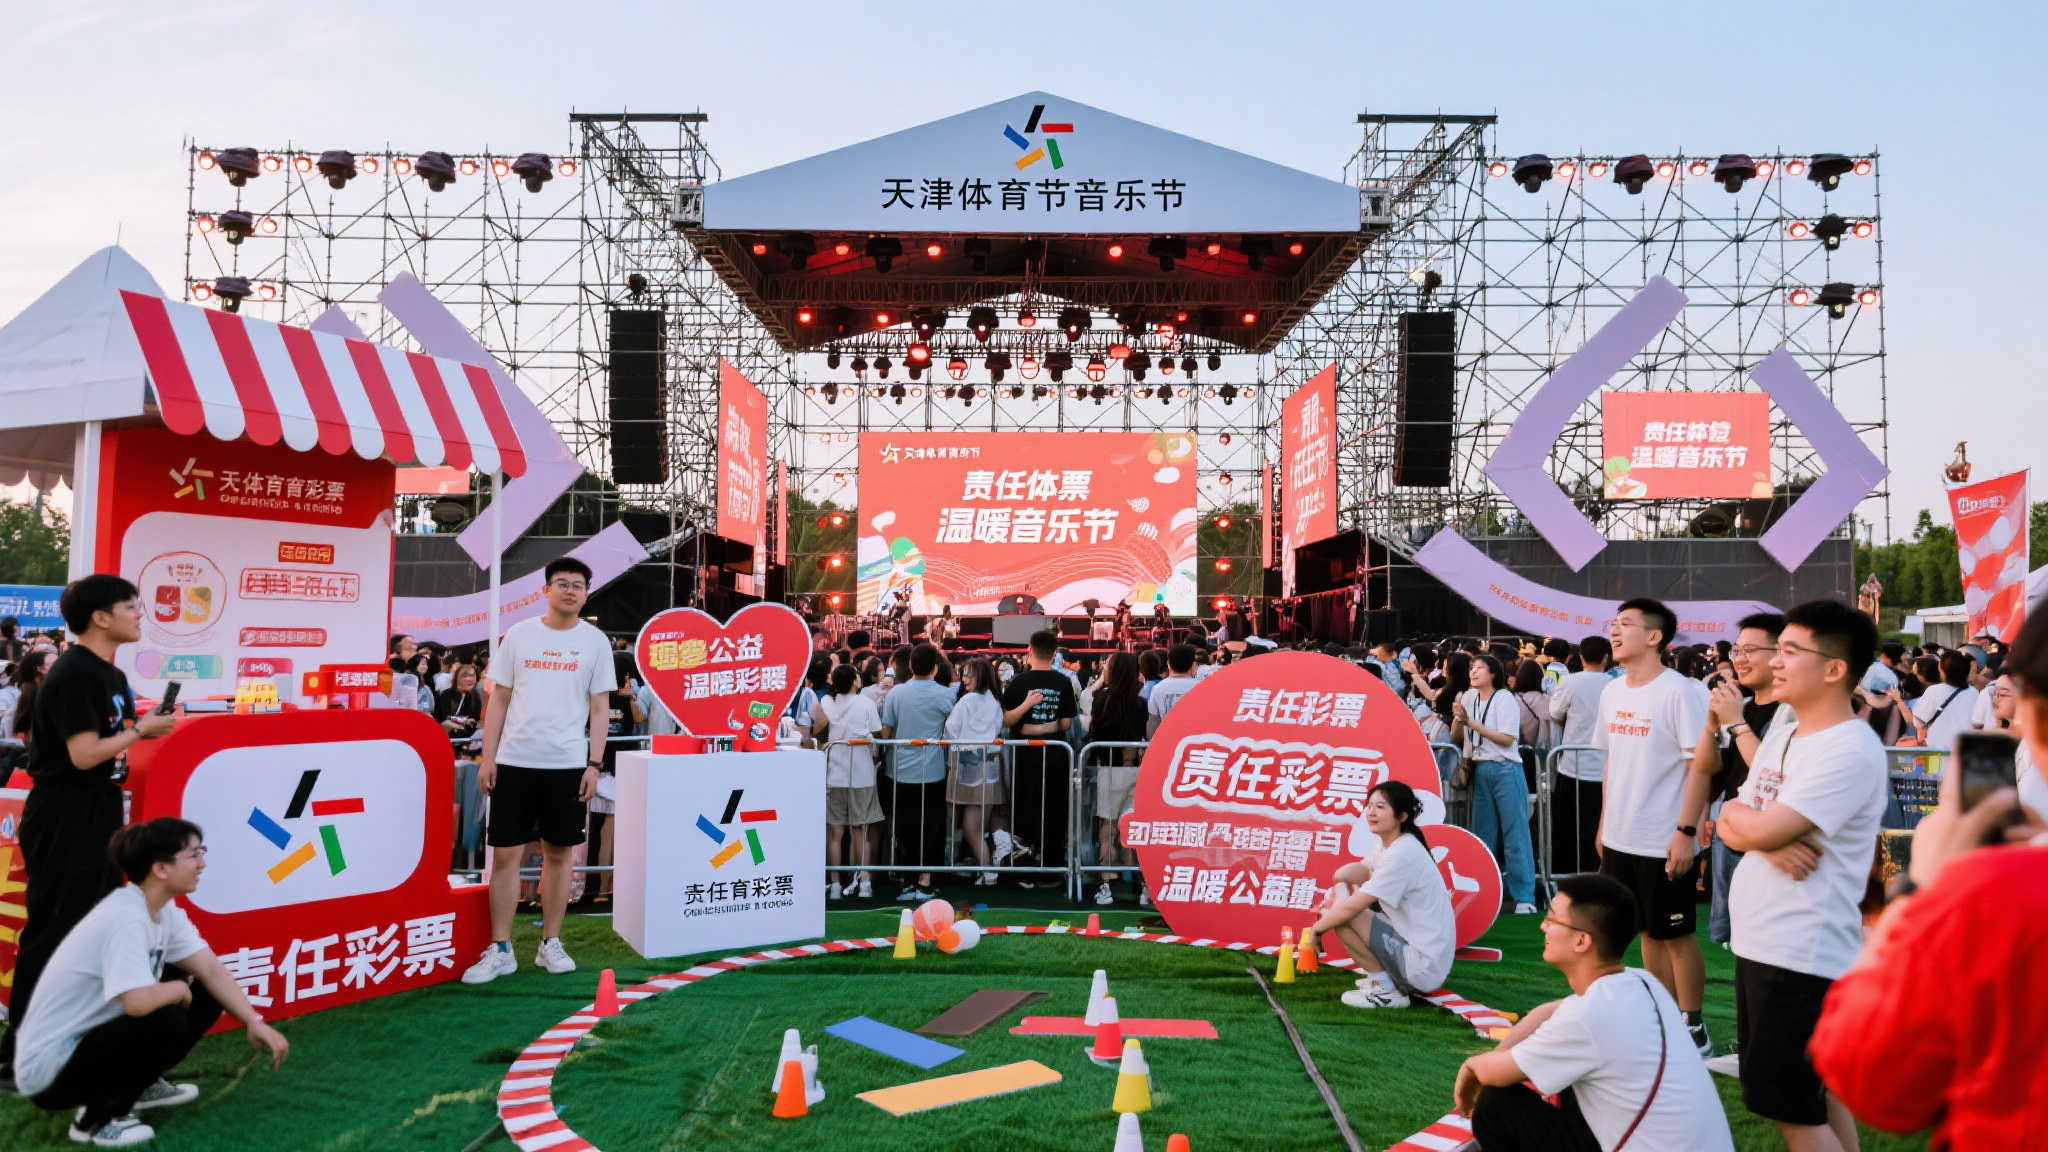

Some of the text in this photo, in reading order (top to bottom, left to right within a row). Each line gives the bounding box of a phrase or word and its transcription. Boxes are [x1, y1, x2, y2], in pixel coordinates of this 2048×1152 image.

[881, 177, 1186, 212] 天津体育节音乐节
[962, 470, 1093, 501] 责任体票
[935, 507, 1119, 544] 温暖音乐节
[1233, 688, 1368, 728] 责任彩票
[1176, 749, 1380, 812] 责任彩票
[684, 875, 794, 905] 责任育彩票
[216, 912, 456, 1007] 责任彩票
